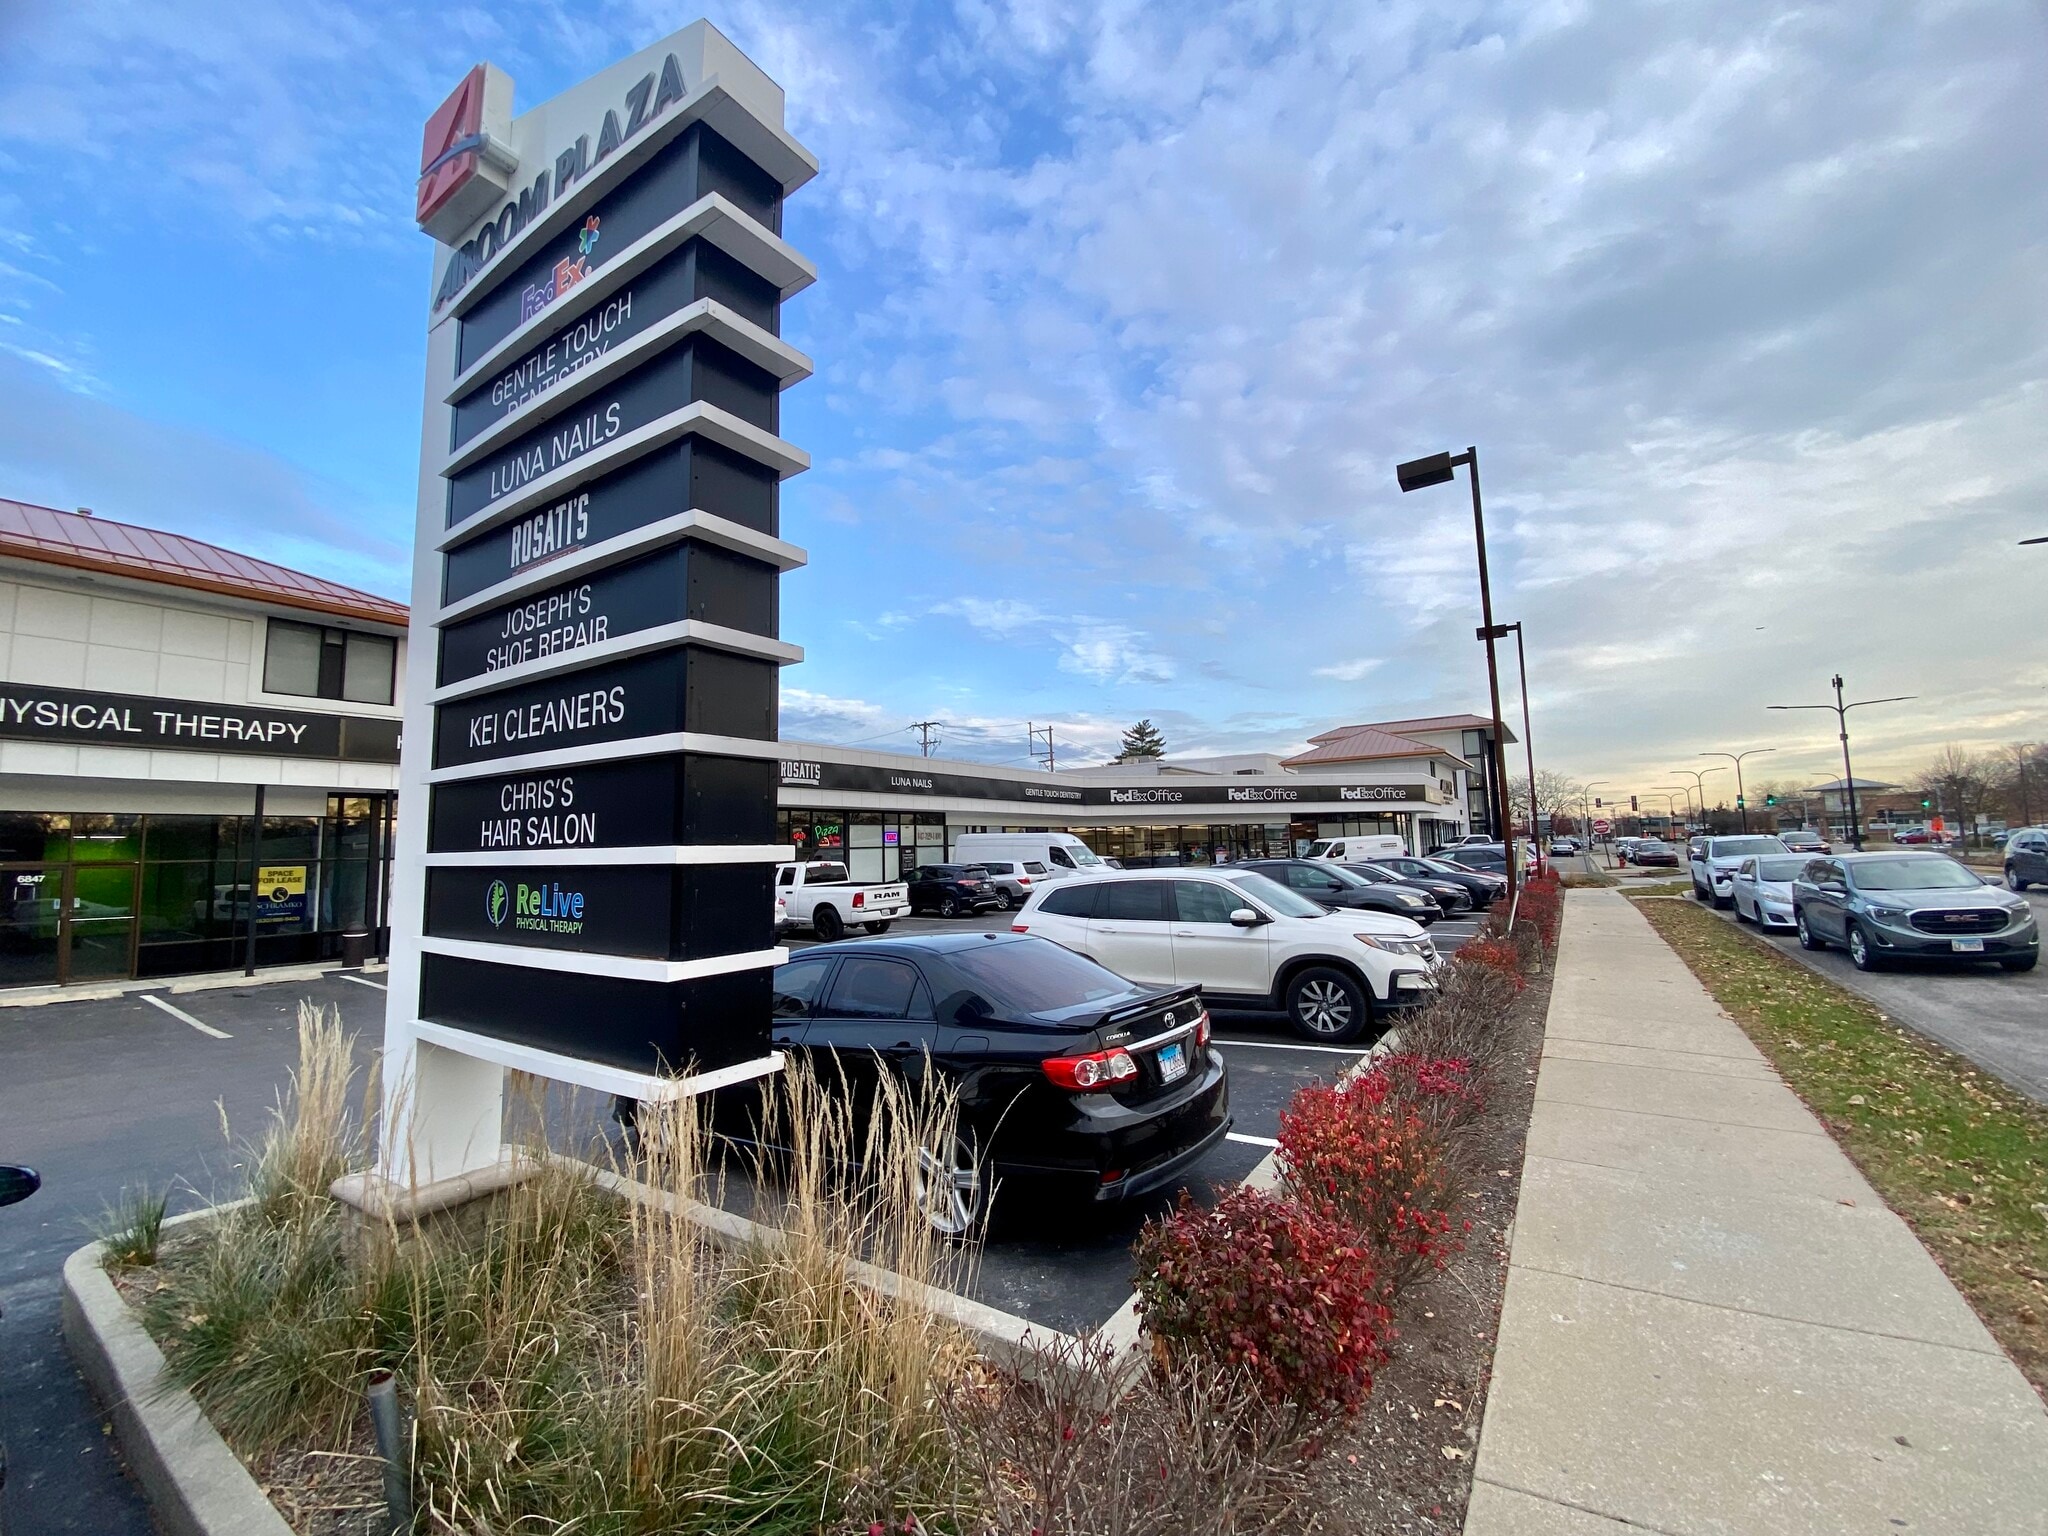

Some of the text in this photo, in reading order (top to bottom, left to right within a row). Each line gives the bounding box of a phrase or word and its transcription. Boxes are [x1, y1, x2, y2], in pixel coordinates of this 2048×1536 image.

[555, 52, 687, 197] PLAZA
[521, 256, 587, 324] FedEx
[492, 291, 632, 406] GENTLE TOUCH
[490, 402, 621, 499] LUNA NAILS
[510, 493, 589, 569] ROSATI'S
[501, 584, 591, 639] JOSEPH'S
[539, 615, 608, 658] REPAIR
[0, 697, 307, 745] YSICAL THERAPY
[469, 685, 626, 748] KEI CLEANERS
[780, 761, 820, 779] ROSATI'S
[891, 776, 933, 790] LUNA NAILS
[501, 777, 574, 812] CHRIS'S
[1025, 788, 1081, 800] GENTLE TOUCH DENTISTRY
[1110, 789, 1183, 802] FedEx Office
[1228, 788, 1298, 801] FedEx Office
[1340, 787, 1406, 799] FedEx Office
[480, 813, 596, 848] HAIR SALON
[17, 875, 46, 883] 6847
[873, 891, 900, 899] RAM
[516, 882, 584, 919] ReLive
[516, 917, 584, 935] PHYSICAL THERAPY
